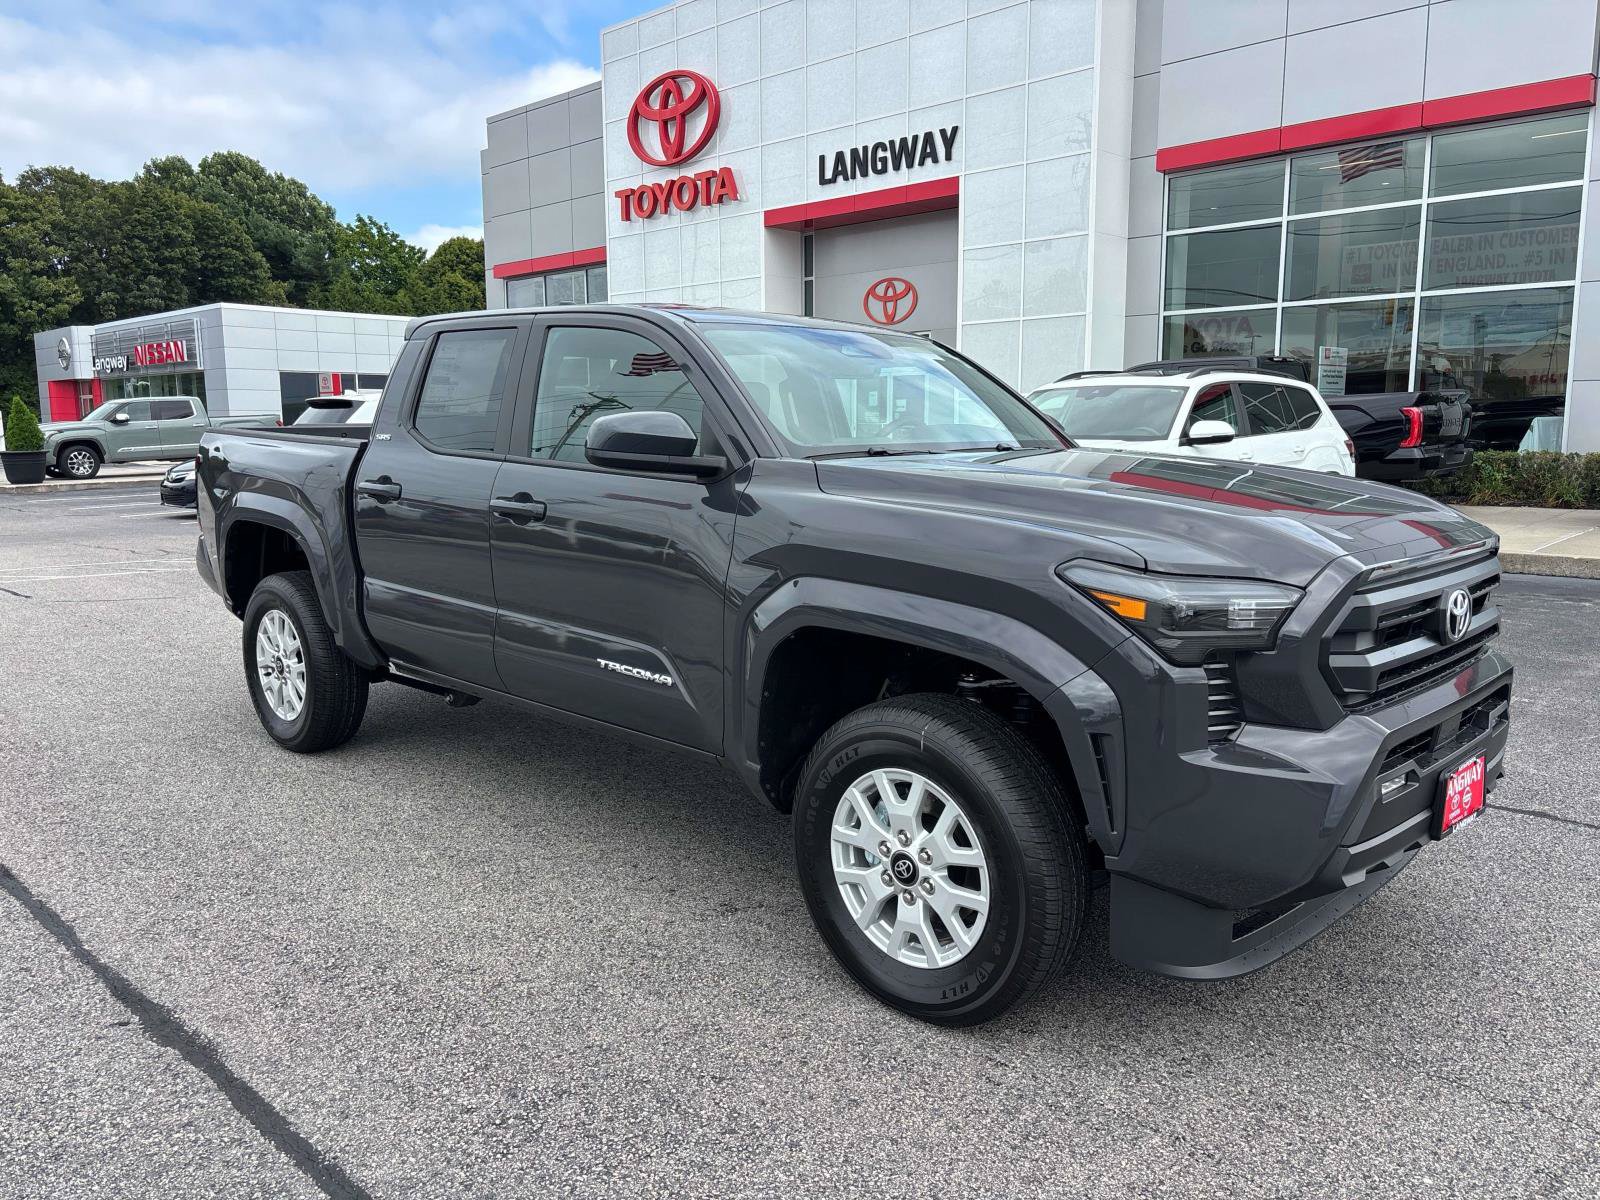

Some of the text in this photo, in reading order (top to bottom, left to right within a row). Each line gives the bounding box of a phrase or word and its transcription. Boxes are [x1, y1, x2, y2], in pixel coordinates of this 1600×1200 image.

[818, 125, 959, 186] LANGWAY
[614, 166, 740, 222] TOYOTA
[1432, 237, 1474, 256] EALER
[1478, 234, 1494, 251] IN
[1382, 262, 1397, 279] IN
[1550, 247, 1566, 265] IN
[91, 340, 188, 373] Langway NISSAN
[596, 658, 673, 687] TACOMA
